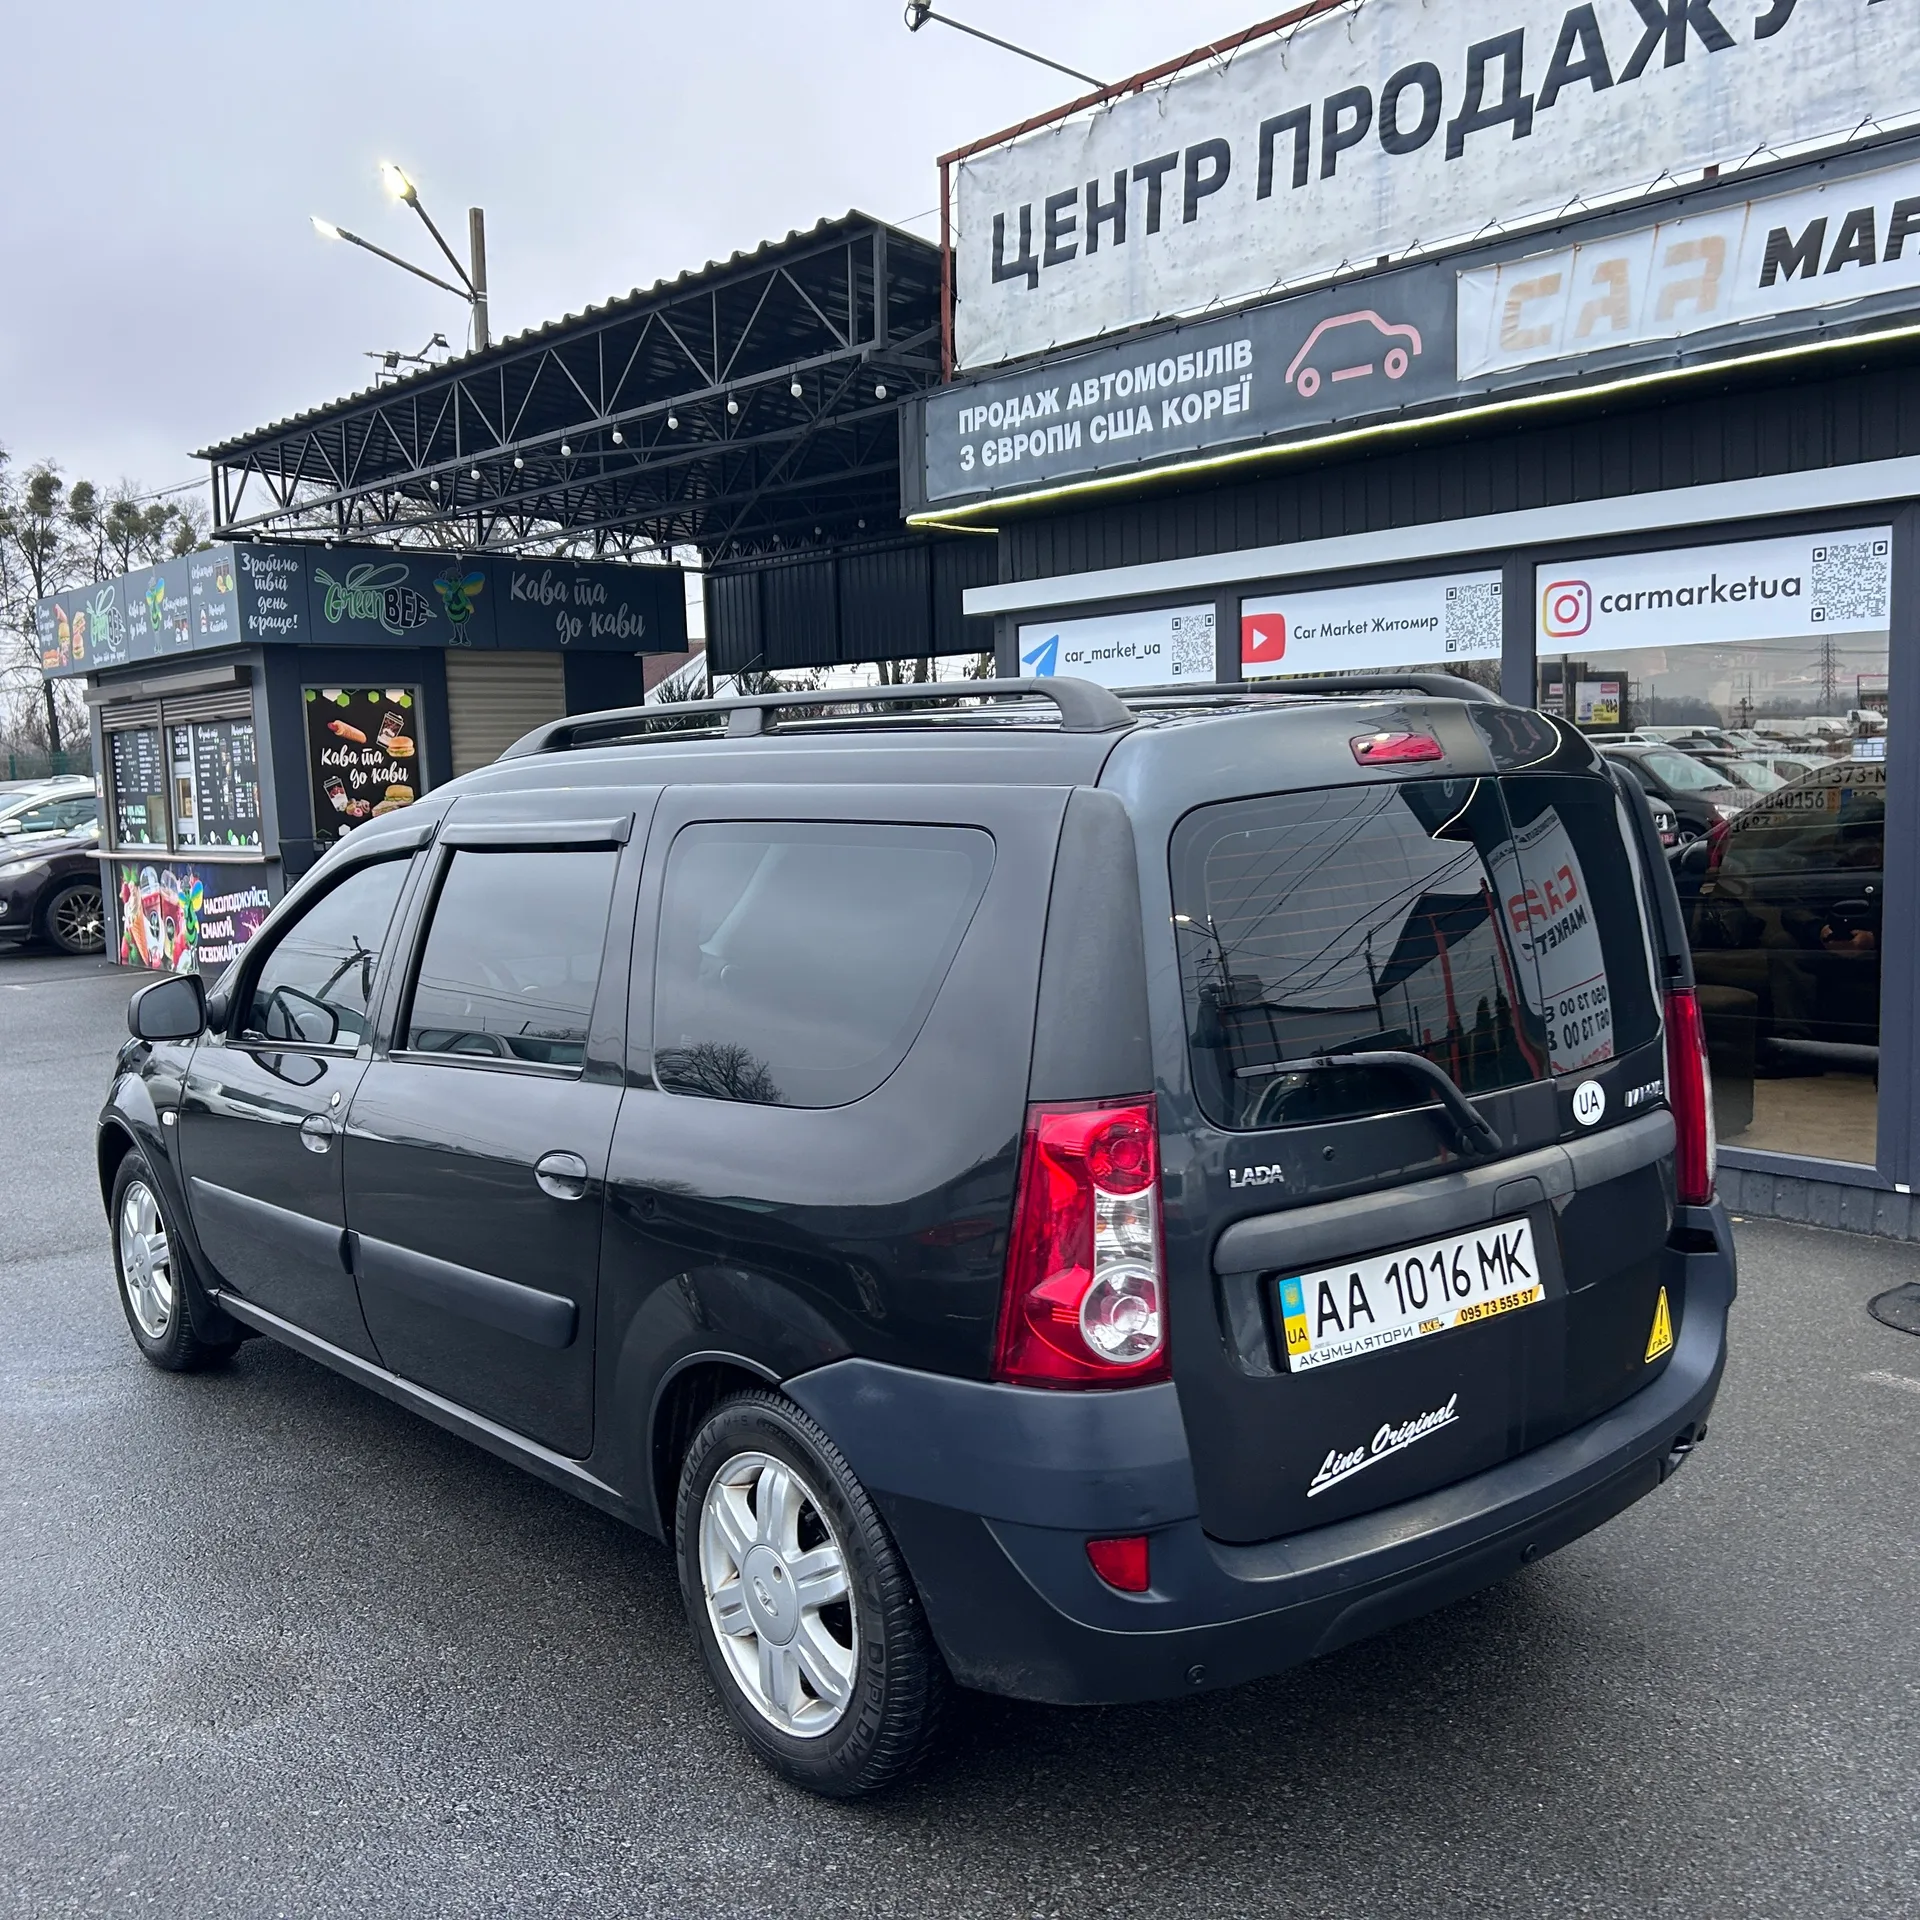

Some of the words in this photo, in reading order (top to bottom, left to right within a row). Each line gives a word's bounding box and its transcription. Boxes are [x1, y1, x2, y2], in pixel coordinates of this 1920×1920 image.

[990, 137, 1231, 290] ЦЕНТР
[1500, 235, 1726, 353] CAR
[958, 387, 1060, 435] ПРОДАЖ
[1066, 339, 1253, 411] АВТОМОБІЛІВ
[959, 444, 975, 471] З
[981, 419, 1082, 467] ЄВРОПИ
[1089, 405, 1154, 444] США
[1161, 373, 1253, 429] КОРЕЇ
[241, 552, 299, 578] Зробимо
[254, 571, 288, 592] твій
[510, 568, 569, 606] Кава
[573, 577, 608, 607] та
[1599, 573, 1801, 614] carmarketua
[257, 596, 288, 615] день
[248, 614, 299, 636] краще!
[555, 610, 584, 645] до
[588, 602, 646, 639] кави
[1293, 624, 1317, 641] Car
[1320, 618, 1369, 638] Market
[1371, 613, 1440, 640] Житомир
[1064, 640, 1162, 666] car_market_ua
[321, 744, 359, 768] Кава
[361, 748, 385, 766] та
[350, 768, 367, 790] до
[371, 761, 409, 784] кави
[203, 885, 271, 915] НАСОЛОДЖУЙСЯ,
[201, 916, 235, 939] СМАКУЙ,
[1579, 1090, 1601, 1115] UA
[1229, 1164, 1285, 1188] LADA
[1316, 1272, 1375, 1338] AA
[1384, 1245, 1472, 1316] 1016
[1475, 1228, 1532, 1292] MK
[1287, 1327, 1308, 1346] UA
[1298, 1326, 1414, 1368] АКУМУЛЯТОРИ
[1461, 1304, 1482, 1322] 095
[1483, 1299, 1498, 1316] 73
[1499, 1293, 1520, 1312] 555
[1521, 1289, 1534, 1304] 37
[1311, 1446, 1365, 1487] Line
[1371, 1392, 1458, 1455] Original
